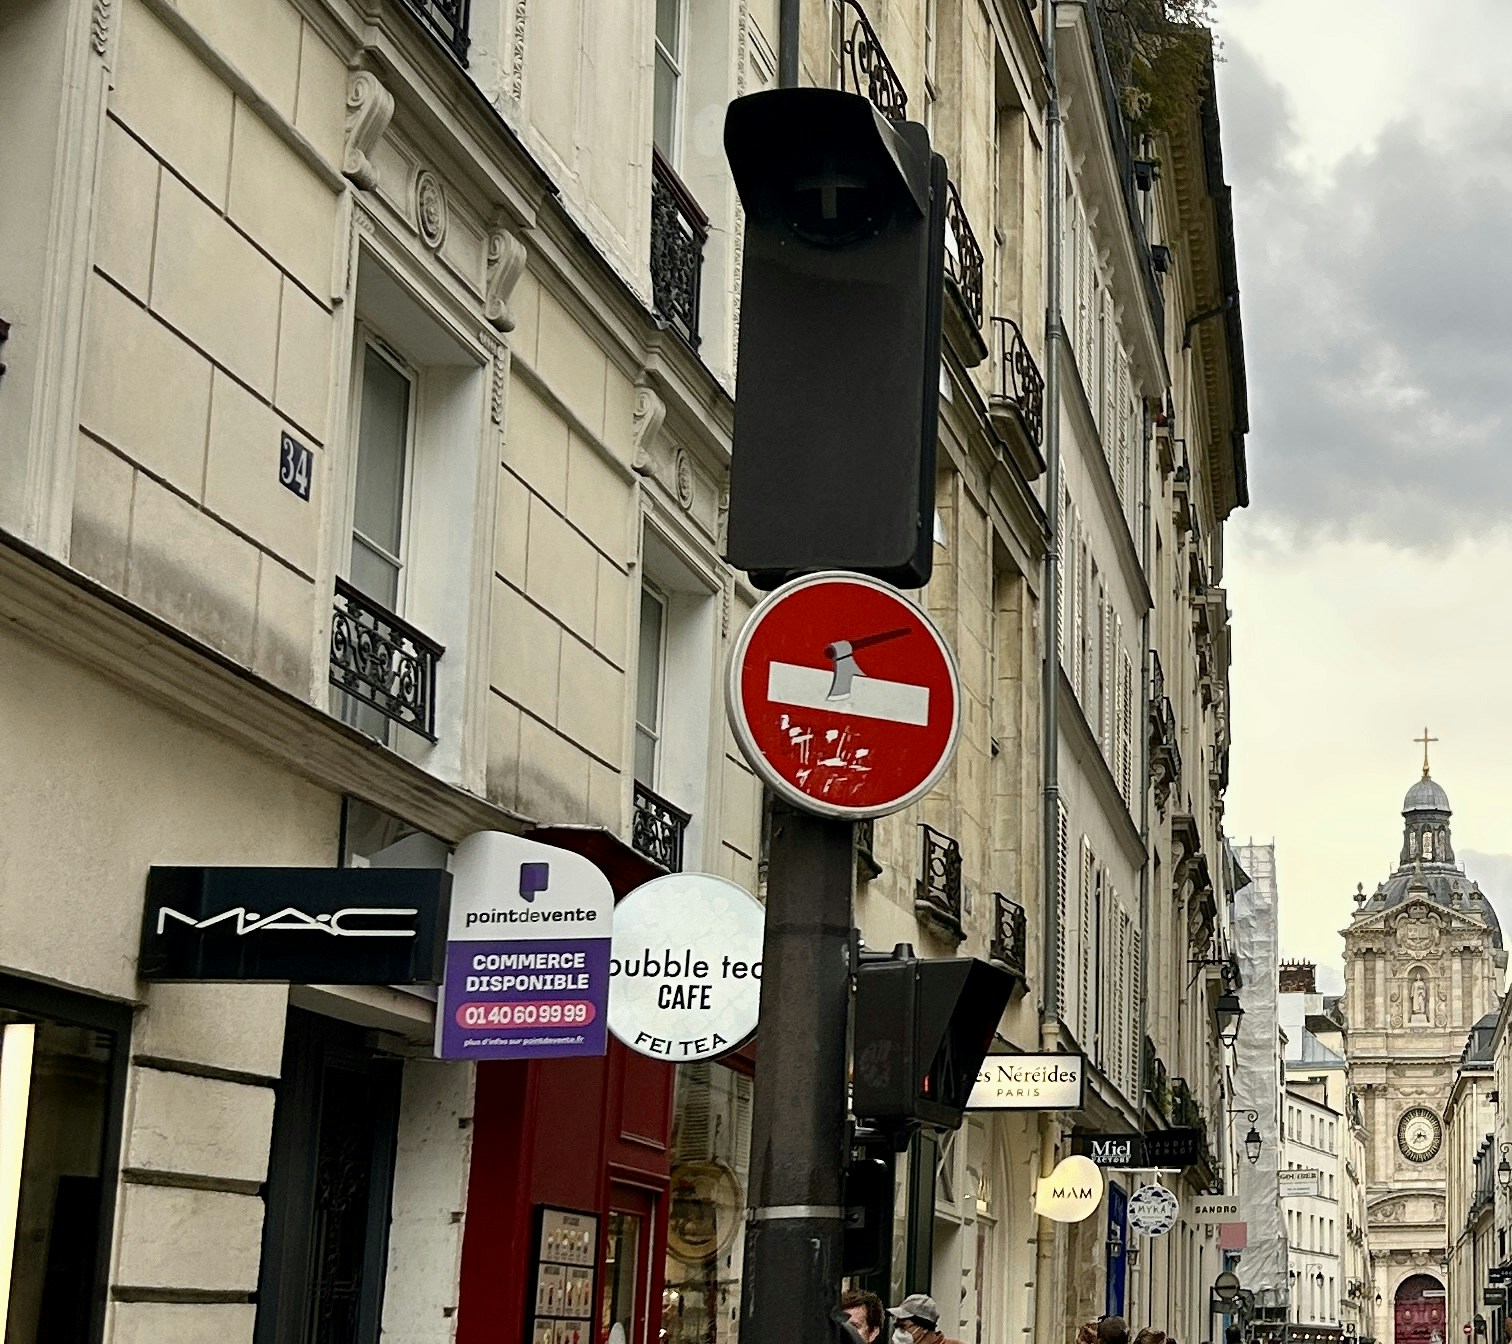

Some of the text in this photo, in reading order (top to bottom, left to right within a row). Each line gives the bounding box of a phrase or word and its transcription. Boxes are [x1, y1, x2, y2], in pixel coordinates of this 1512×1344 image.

[281, 437, 308, 496] 34
[465, 908, 597, 928] pointdevente
[472, 952, 586, 971] COMMERCE
[465, 973, 589, 992] DISPONIBLE
[657, 984, 713, 1010] CAFE
[463, 1038, 481, 1048] plus
[508, 1037, 523, 1045] sur
[522, 1035, 585, 1047] pointdevente.fr
[634, 1031, 728, 1056] FEI TEA
[997, 1064, 1077, 1083] Néréides
[996, 1088, 1040, 1097] PARIS
[1091, 1140, 1132, 1156] Miel
[1052, 1186, 1092, 1199] MAM
[1195, 1205, 1238, 1214] SANDRO
